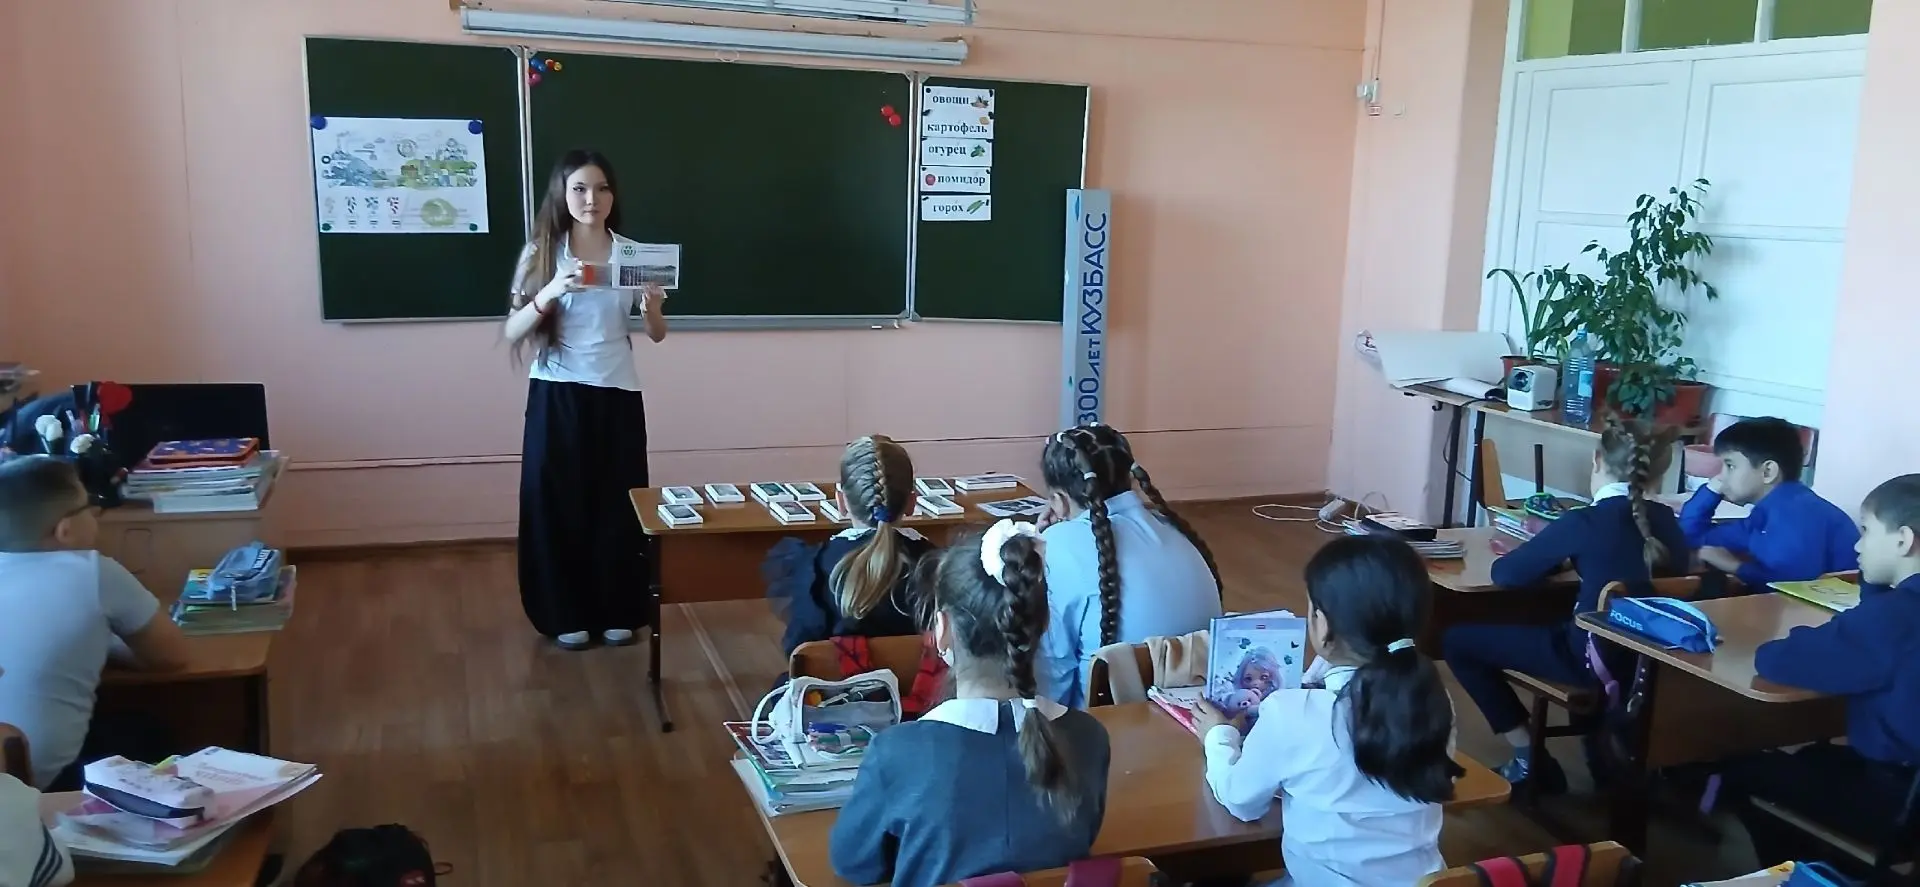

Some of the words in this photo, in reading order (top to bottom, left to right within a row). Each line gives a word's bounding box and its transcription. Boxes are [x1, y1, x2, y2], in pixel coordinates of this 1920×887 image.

[932, 95, 969, 105] овощи
[927, 122, 988, 135] картофель
[928, 146, 967, 157] огурец
[937, 175, 986, 186] помидор
[933, 204, 964, 214] горох
[1081, 213, 1107, 335] КУЗБАСС
[1610, 609, 1644, 631] FOCUS
